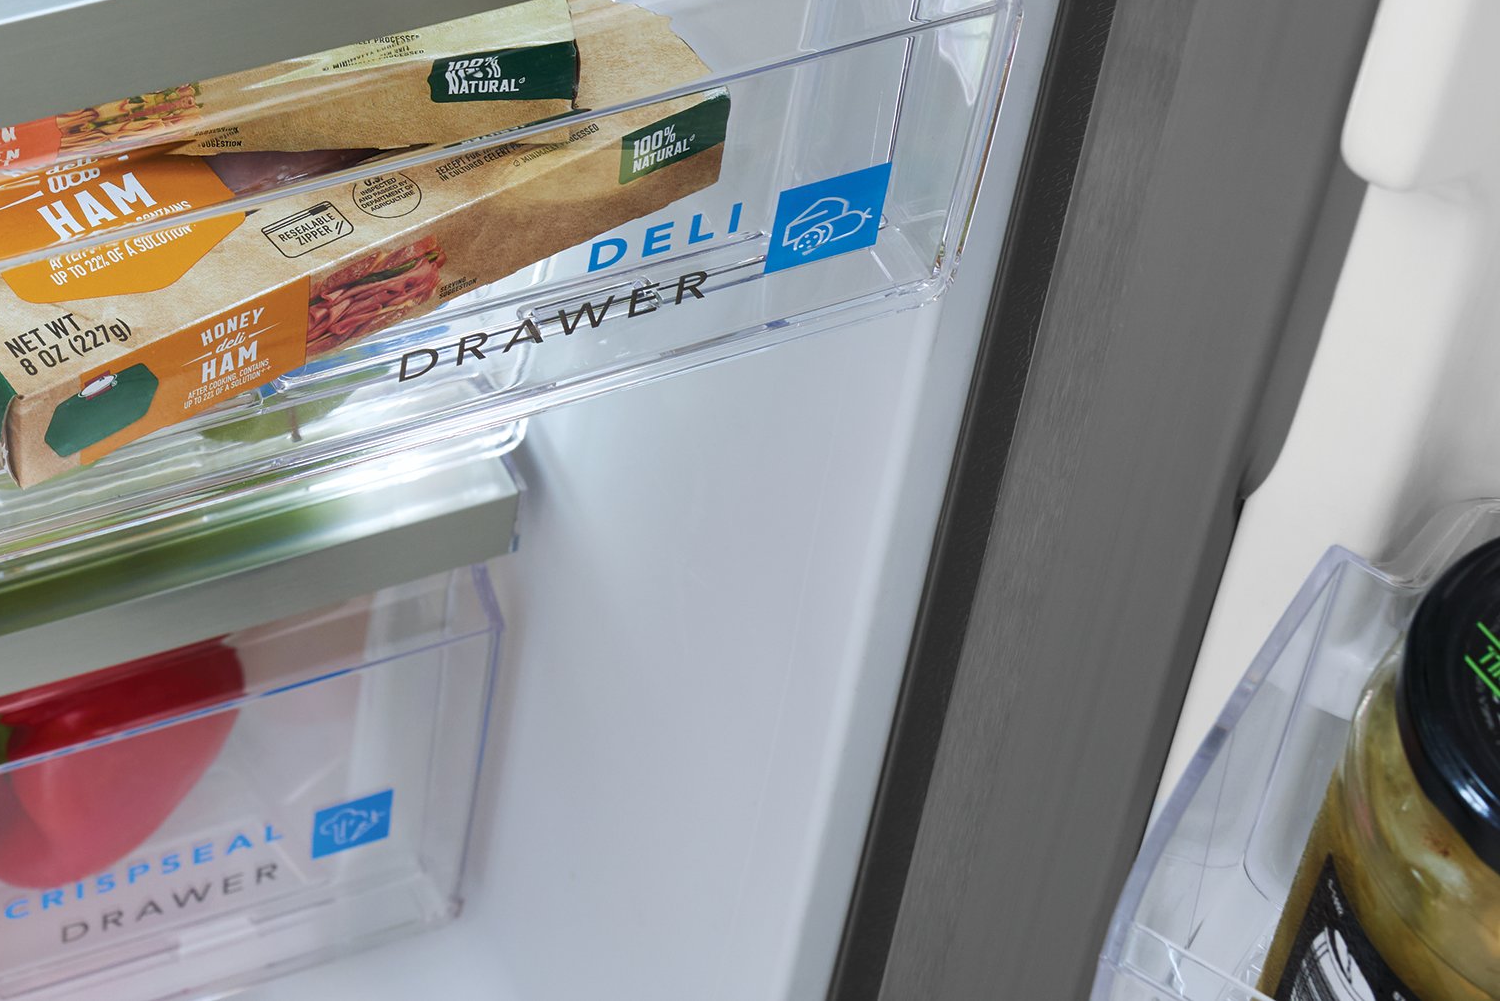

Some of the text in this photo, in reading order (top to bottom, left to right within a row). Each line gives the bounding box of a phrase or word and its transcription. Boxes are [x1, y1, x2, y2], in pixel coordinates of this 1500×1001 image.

[447, 76, 520, 96] NATURAL
[631, 141, 691, 175] NATURAL
[632, 124, 678, 160] 100%
[448, 157, 484, 178] CULTURED
[484, 147, 512, 167] CELERY
[357, 193, 373, 204] AND
[373, 183, 399, 199] PASSED
[359, 176, 398, 197] INSPECTED
[360, 189, 405, 210] DEPARTMENT
[369, 190, 417, 213] AGRICULTURE
[36, 171, 158, 243] HAM
[278, 212, 337, 247] RESEALABLE ZIPPER
[587, 202, 744, 274] DELI
[50, 239, 140, 288] UP TO 22% OF A
[438, 278, 479, 300] SUGGESTION
[439, 276, 469, 293] SERVING
[4, 312, 83, 359] NET WT
[201, 306, 266, 347] HONEY
[215, 331, 247, 354] deli
[398, 269, 709, 383] DRAWER
[18, 317, 133, 377] 8 OZ (227g)
[201, 340, 258, 384] HAM
[187, 358, 270, 400] AFTER CONTAINS
[183, 400, 193, 410] UP
[203, 391, 215, 401] 22%
[3, 823, 286, 921] CRISPSEAL
[60, 861, 280, 946] DRAWER
